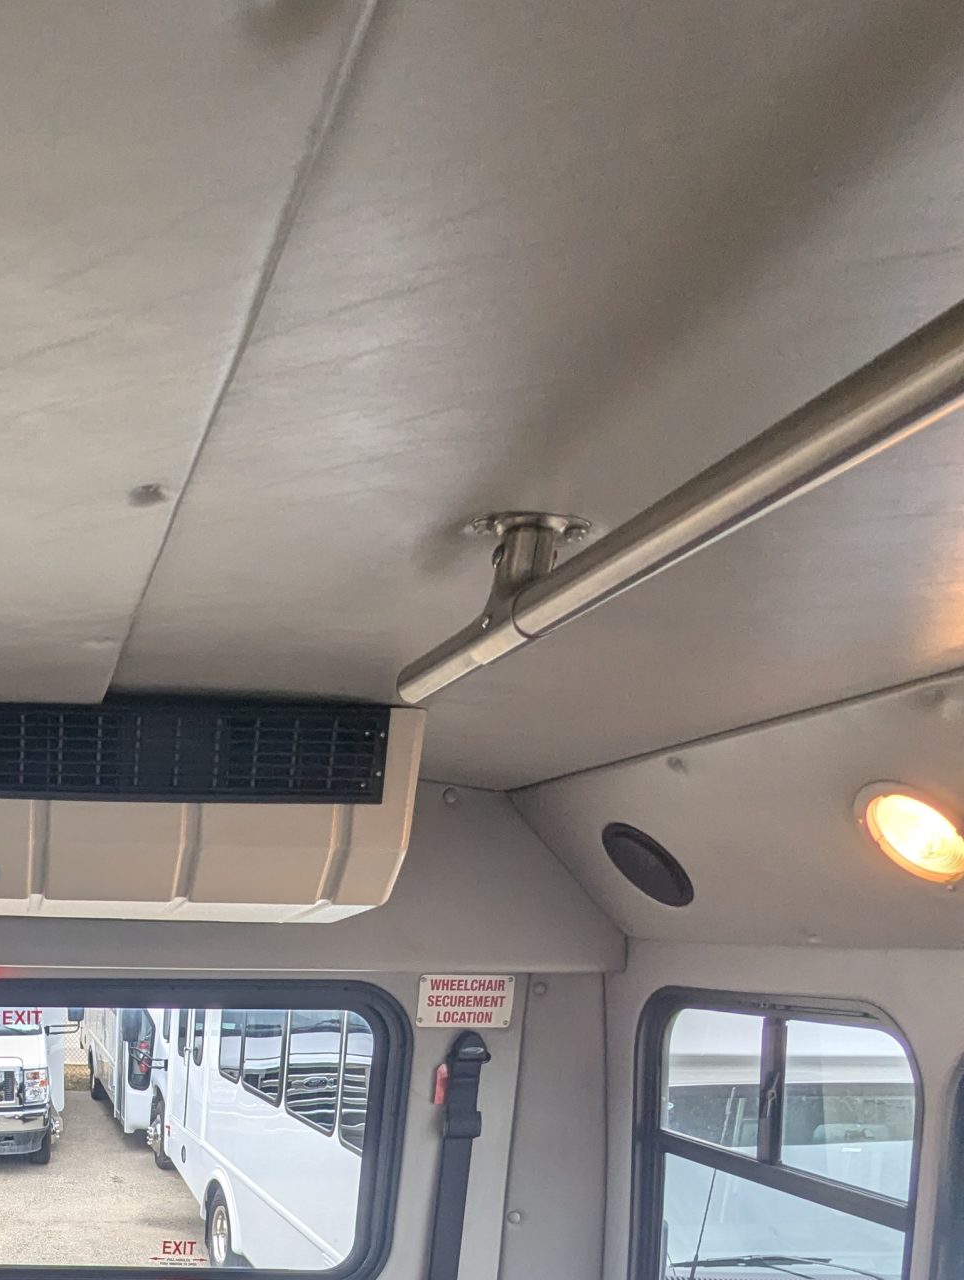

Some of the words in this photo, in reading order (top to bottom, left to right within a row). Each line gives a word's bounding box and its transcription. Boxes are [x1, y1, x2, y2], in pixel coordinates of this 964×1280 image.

[430, 979, 505, 991] WHEELCHAIR
[427, 995, 505, 1007] SECUREMENT
[2, 1011, 42, 1025] EXIT
[436, 1011, 492, 1023] LOCATION
[162, 1241, 196, 1255] EXIT
